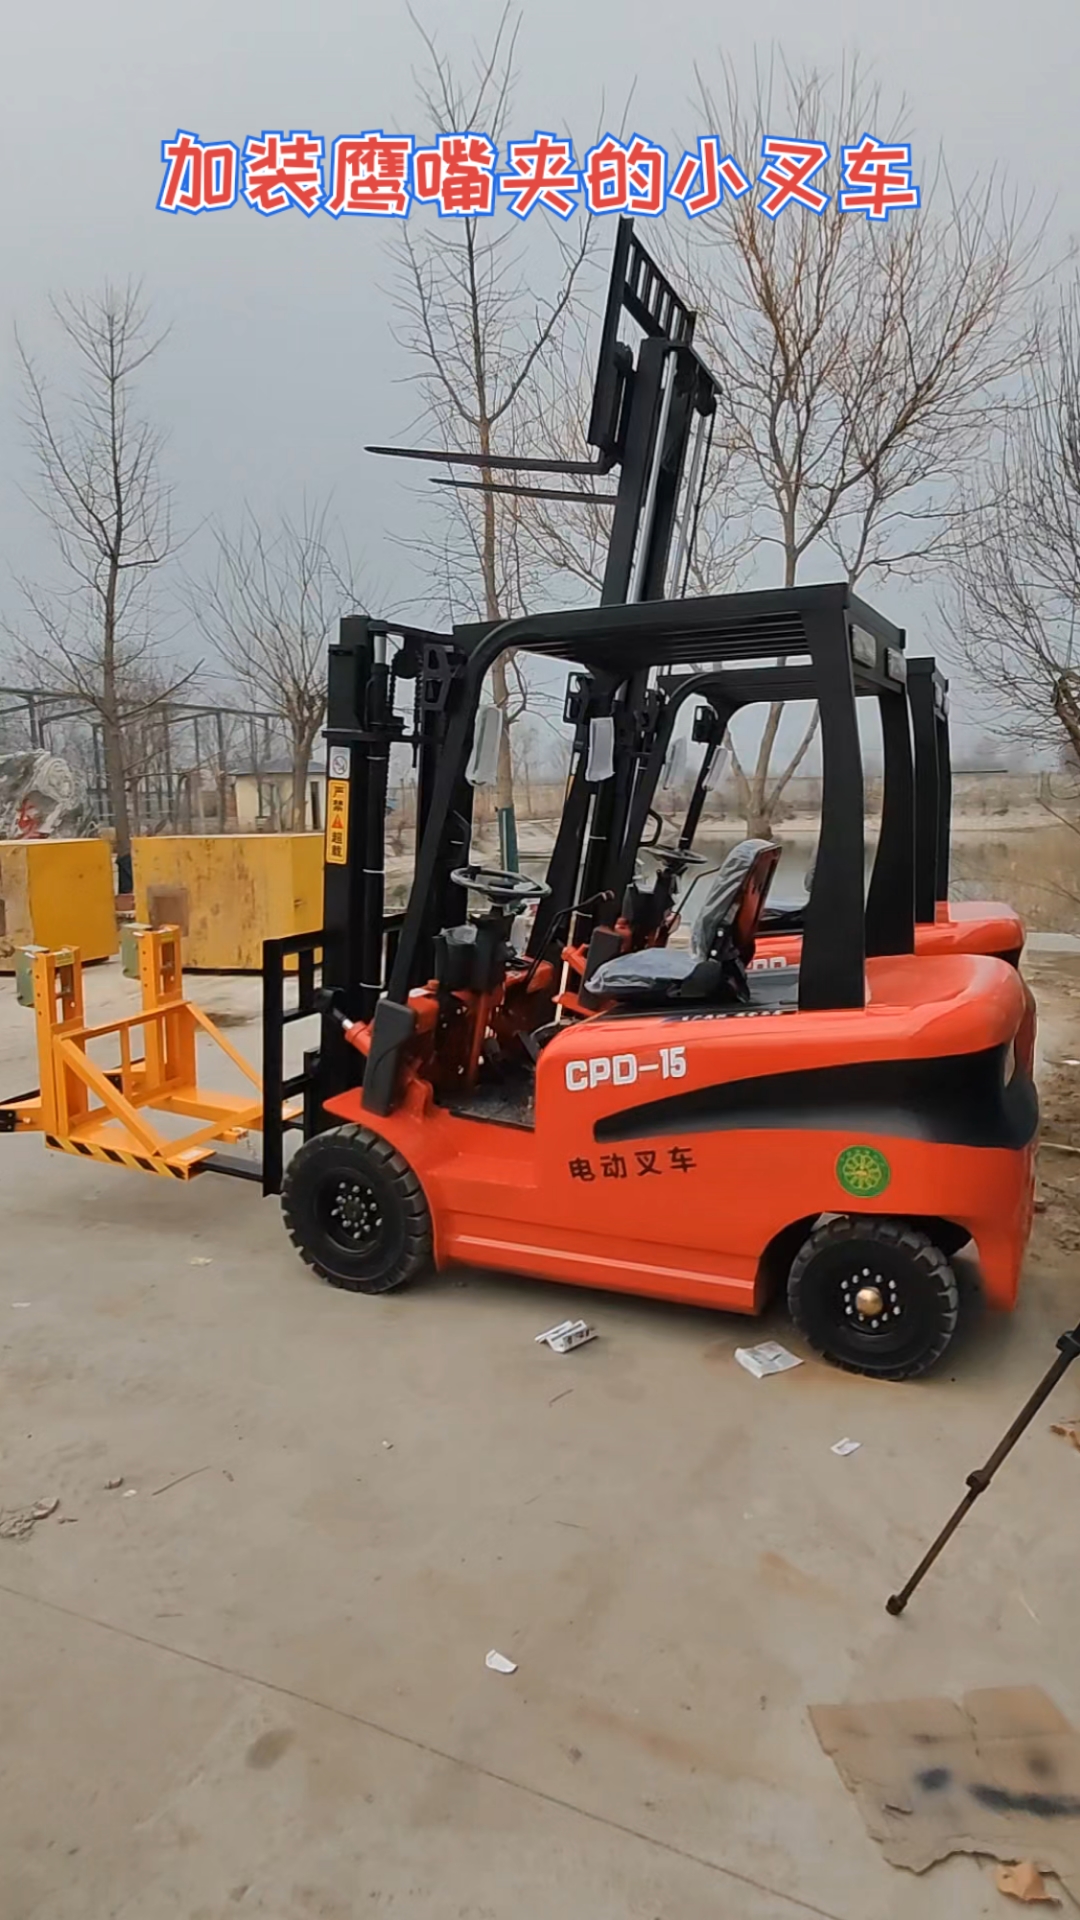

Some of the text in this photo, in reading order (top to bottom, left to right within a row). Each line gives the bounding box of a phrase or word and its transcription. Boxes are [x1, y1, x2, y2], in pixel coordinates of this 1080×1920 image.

[565, 1046, 687, 1092] CPD-15
[568, 1146, 697, 1181] 电动叉车
